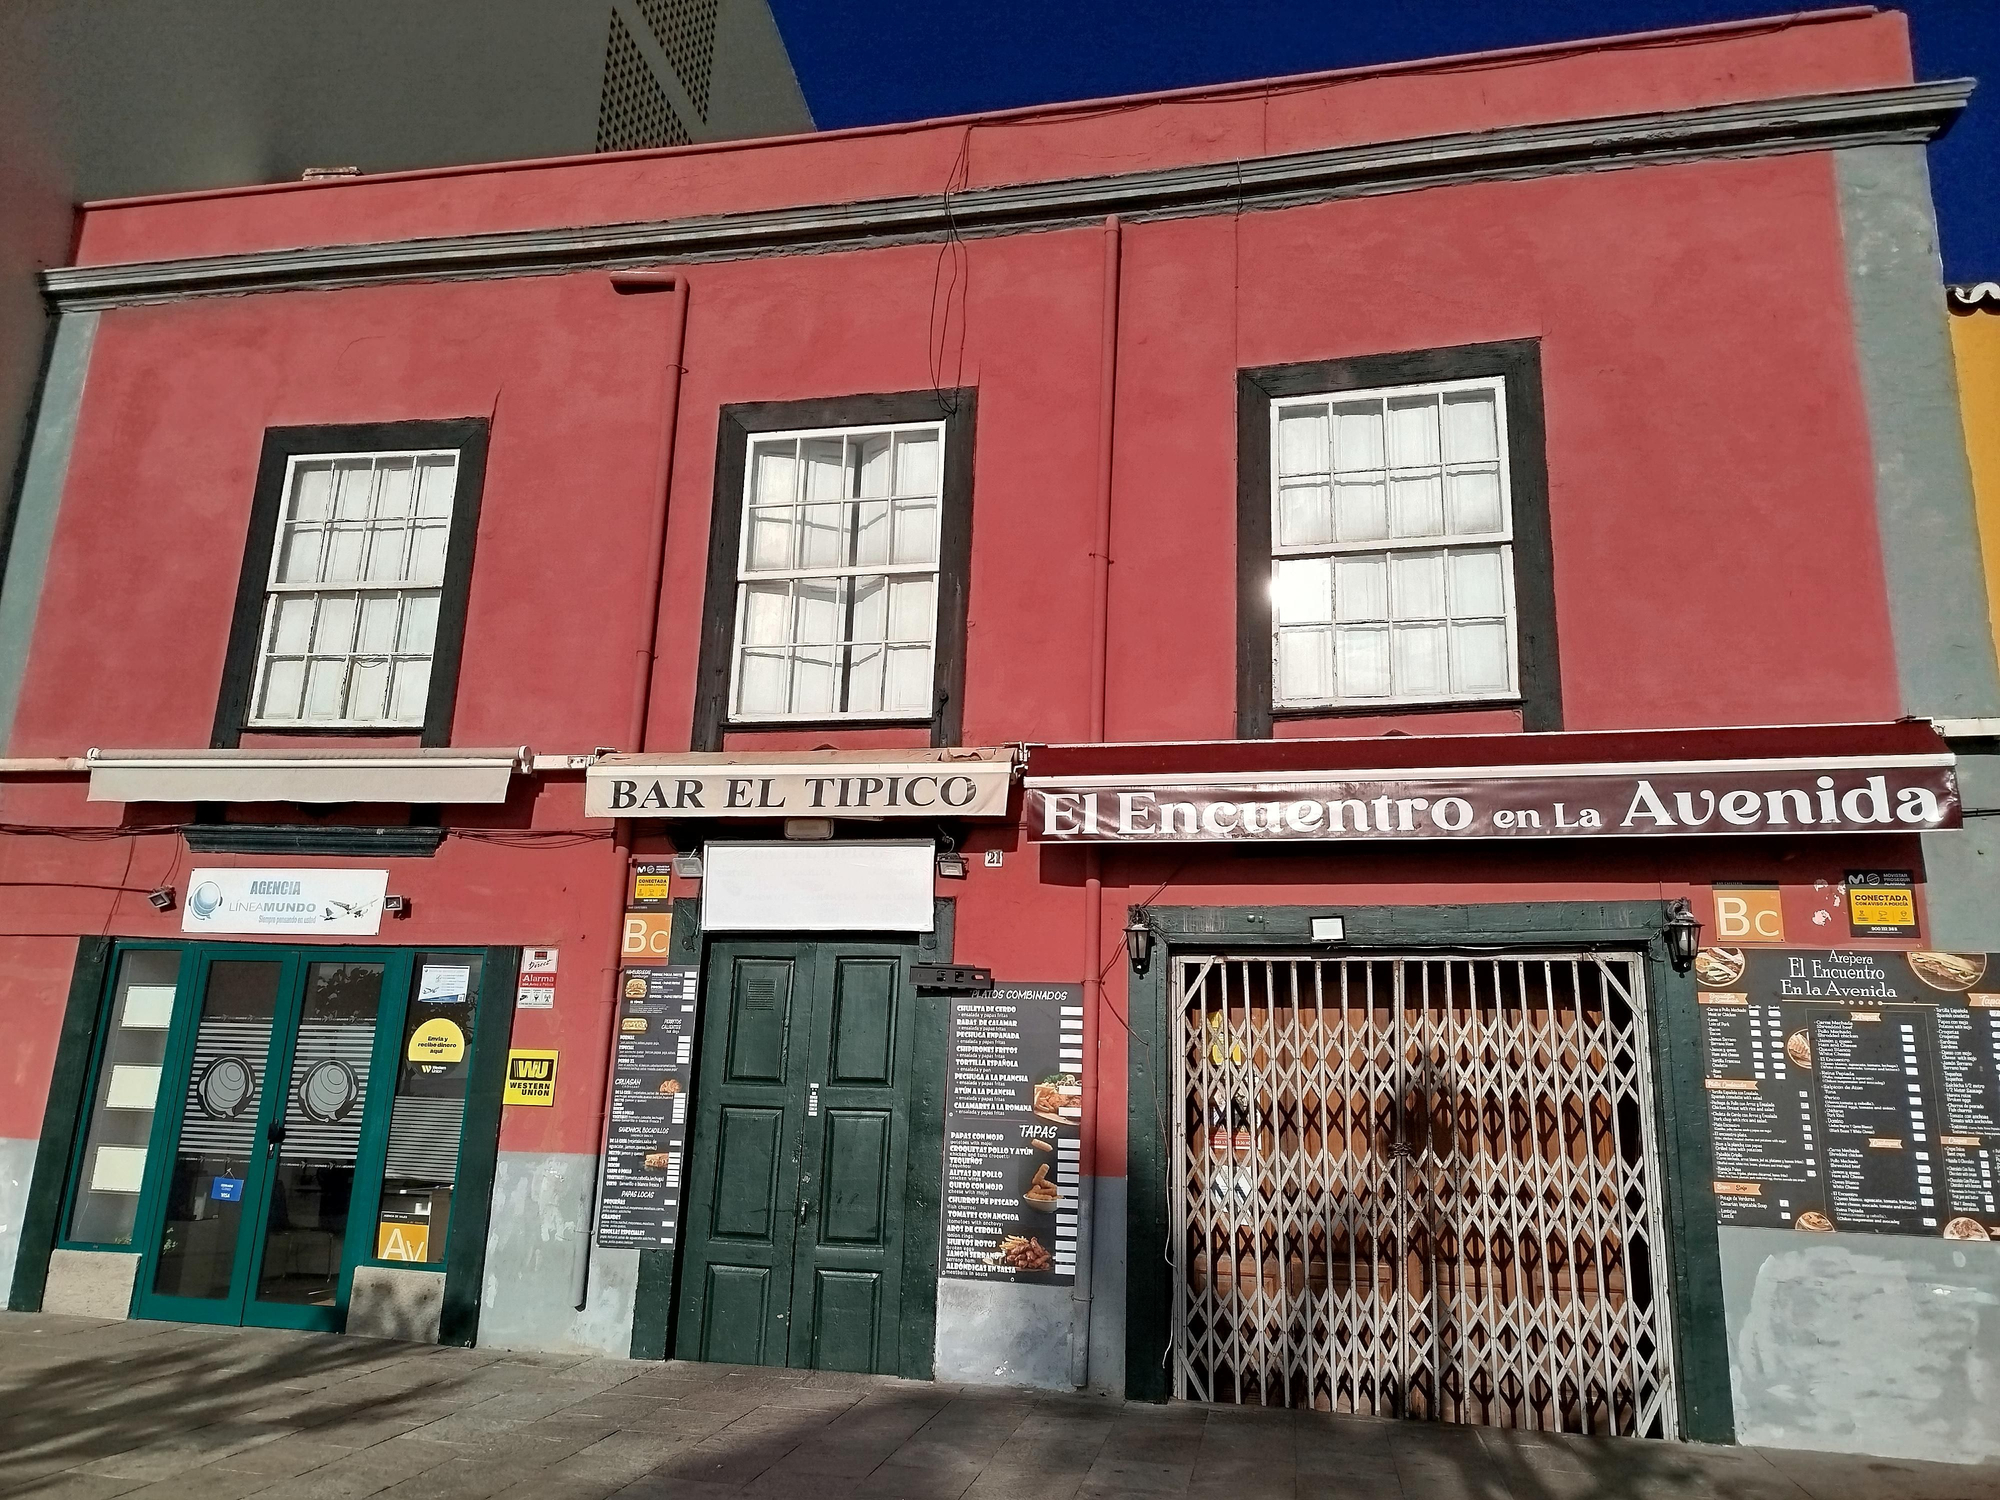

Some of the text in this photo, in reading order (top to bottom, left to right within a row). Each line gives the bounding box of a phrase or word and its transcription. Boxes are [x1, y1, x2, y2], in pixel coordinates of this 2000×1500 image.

[608, 776, 978, 809] BAR EL TIPICO
[1041, 775, 1944, 836] El Encuentro en La Avenida
[987, 851, 1001, 864] 21
[250, 880, 301, 896] AGENCIA
[259, 914, 275, 924] Siempre
[1717, 897, 1780, 937] Bc
[623, 919, 668, 954] Bc
[1829, 949, 1873, 966] Arepera
[1788, 957, 1885, 980] El Encuentro
[522, 974, 554, 983] Alarma
[1780, 979, 1898, 998] En la Avenida
[1006, 990, 1068, 1001] COMBINADOS
[956, 1045, 994, 1053] CHIPIRONES
[987, 1059, 1018, 1067] ESPAÑOLA
[999, 1074, 1028, 1082] PLANCHA
[510, 1082, 550, 1090] WESTERN
[954, 1086, 971, 1094] ATÚN
[986, 1088, 1015, 1096] PLANCHA
[954, 1102, 990, 1110] CALAMARES
[1005, 1104, 1033, 1112] ROMANA
[972, 1132, 985, 1140] CON
[1019, 1124, 1058, 1139] TAPAS
[949, 1145, 987, 1153] CROQUETAS
[988, 1146, 1009, 1154] POLLO
[1015, 1147, 1034, 1155] ATÚN
[949, 1156, 983, 1165] TEQUEÑOS
[949, 1181, 1003, 1191] QUESO CON MOJO
[621, 1190, 637, 1198] PAPAS
[948, 1196, 979, 1204] CHURROS
[989, 1198, 1019, 1206] PESCADO
[948, 1210, 1019, 1221] TOMATES CON ANCHOA
[974, 1226, 1002, 1235] CEBOLLA
[947, 1238, 996, 1248] HUEVOS ROTOS
[997, 1266, 1016, 1274] SALSA
